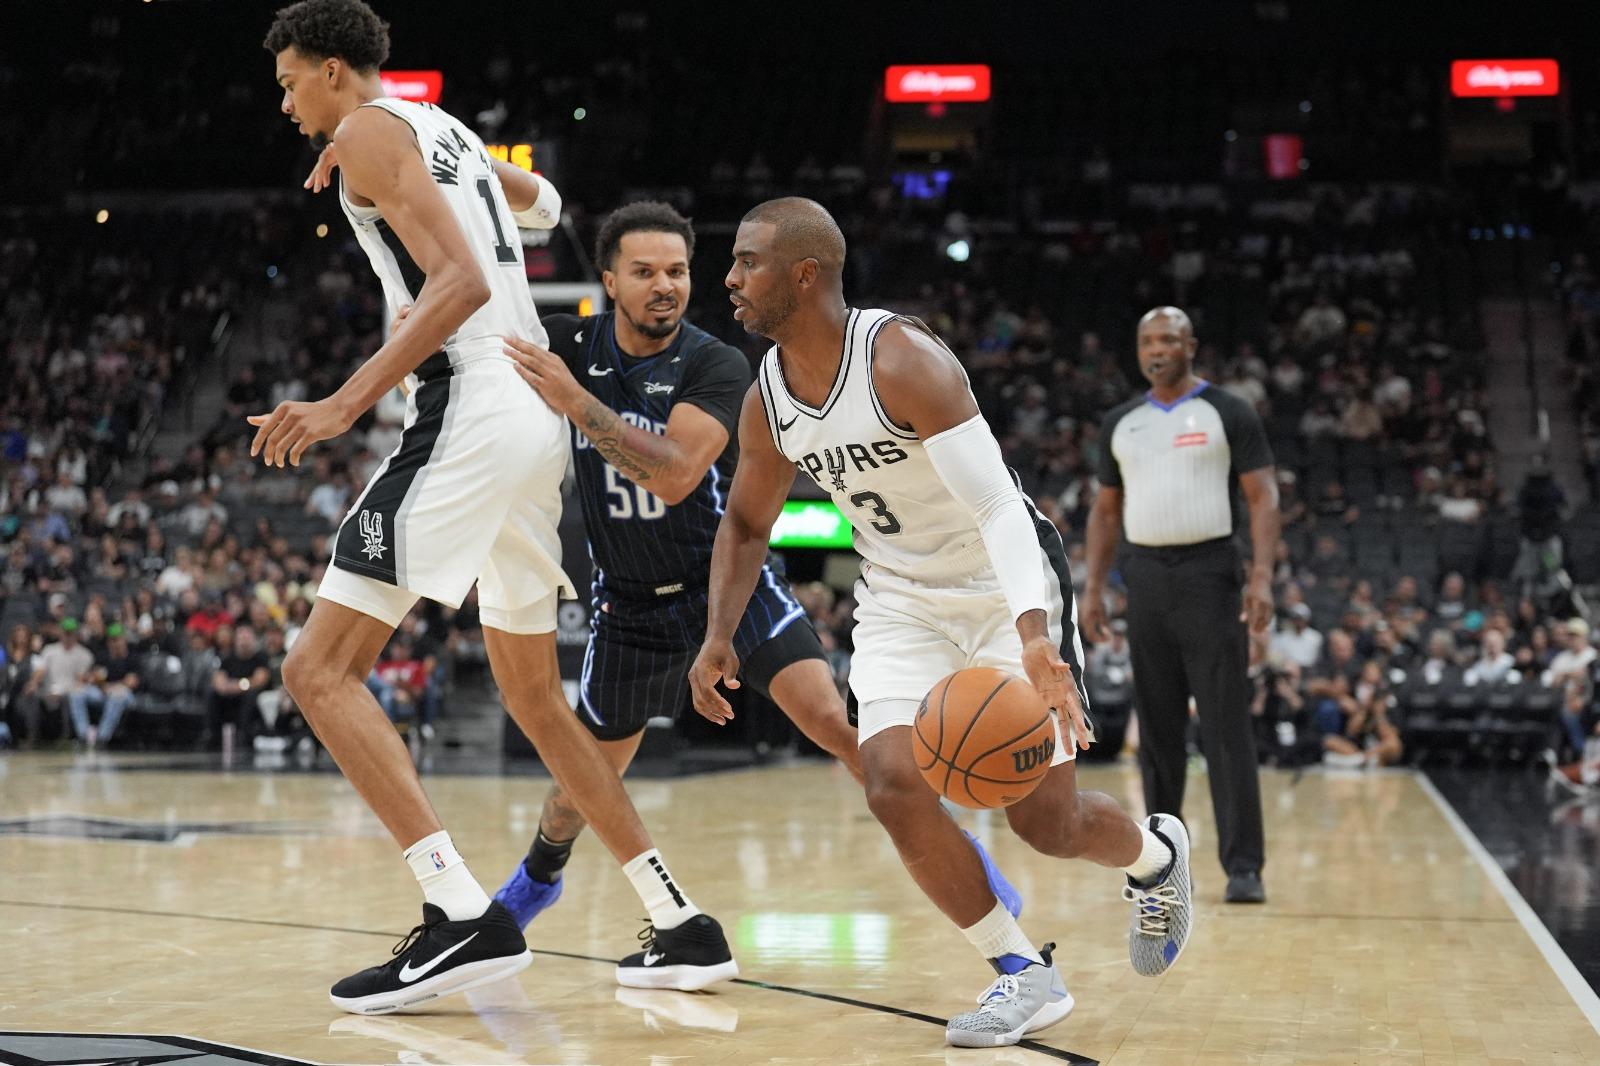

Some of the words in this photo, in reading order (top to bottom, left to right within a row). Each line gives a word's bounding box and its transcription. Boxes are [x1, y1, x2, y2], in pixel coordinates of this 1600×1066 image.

[474, 175, 521, 265] 1
[643, 381, 675, 394] Disney
[603, 461, 667, 521] 50
[848, 489, 903, 537] 3
[655, 583, 685, 597] MAGIC
